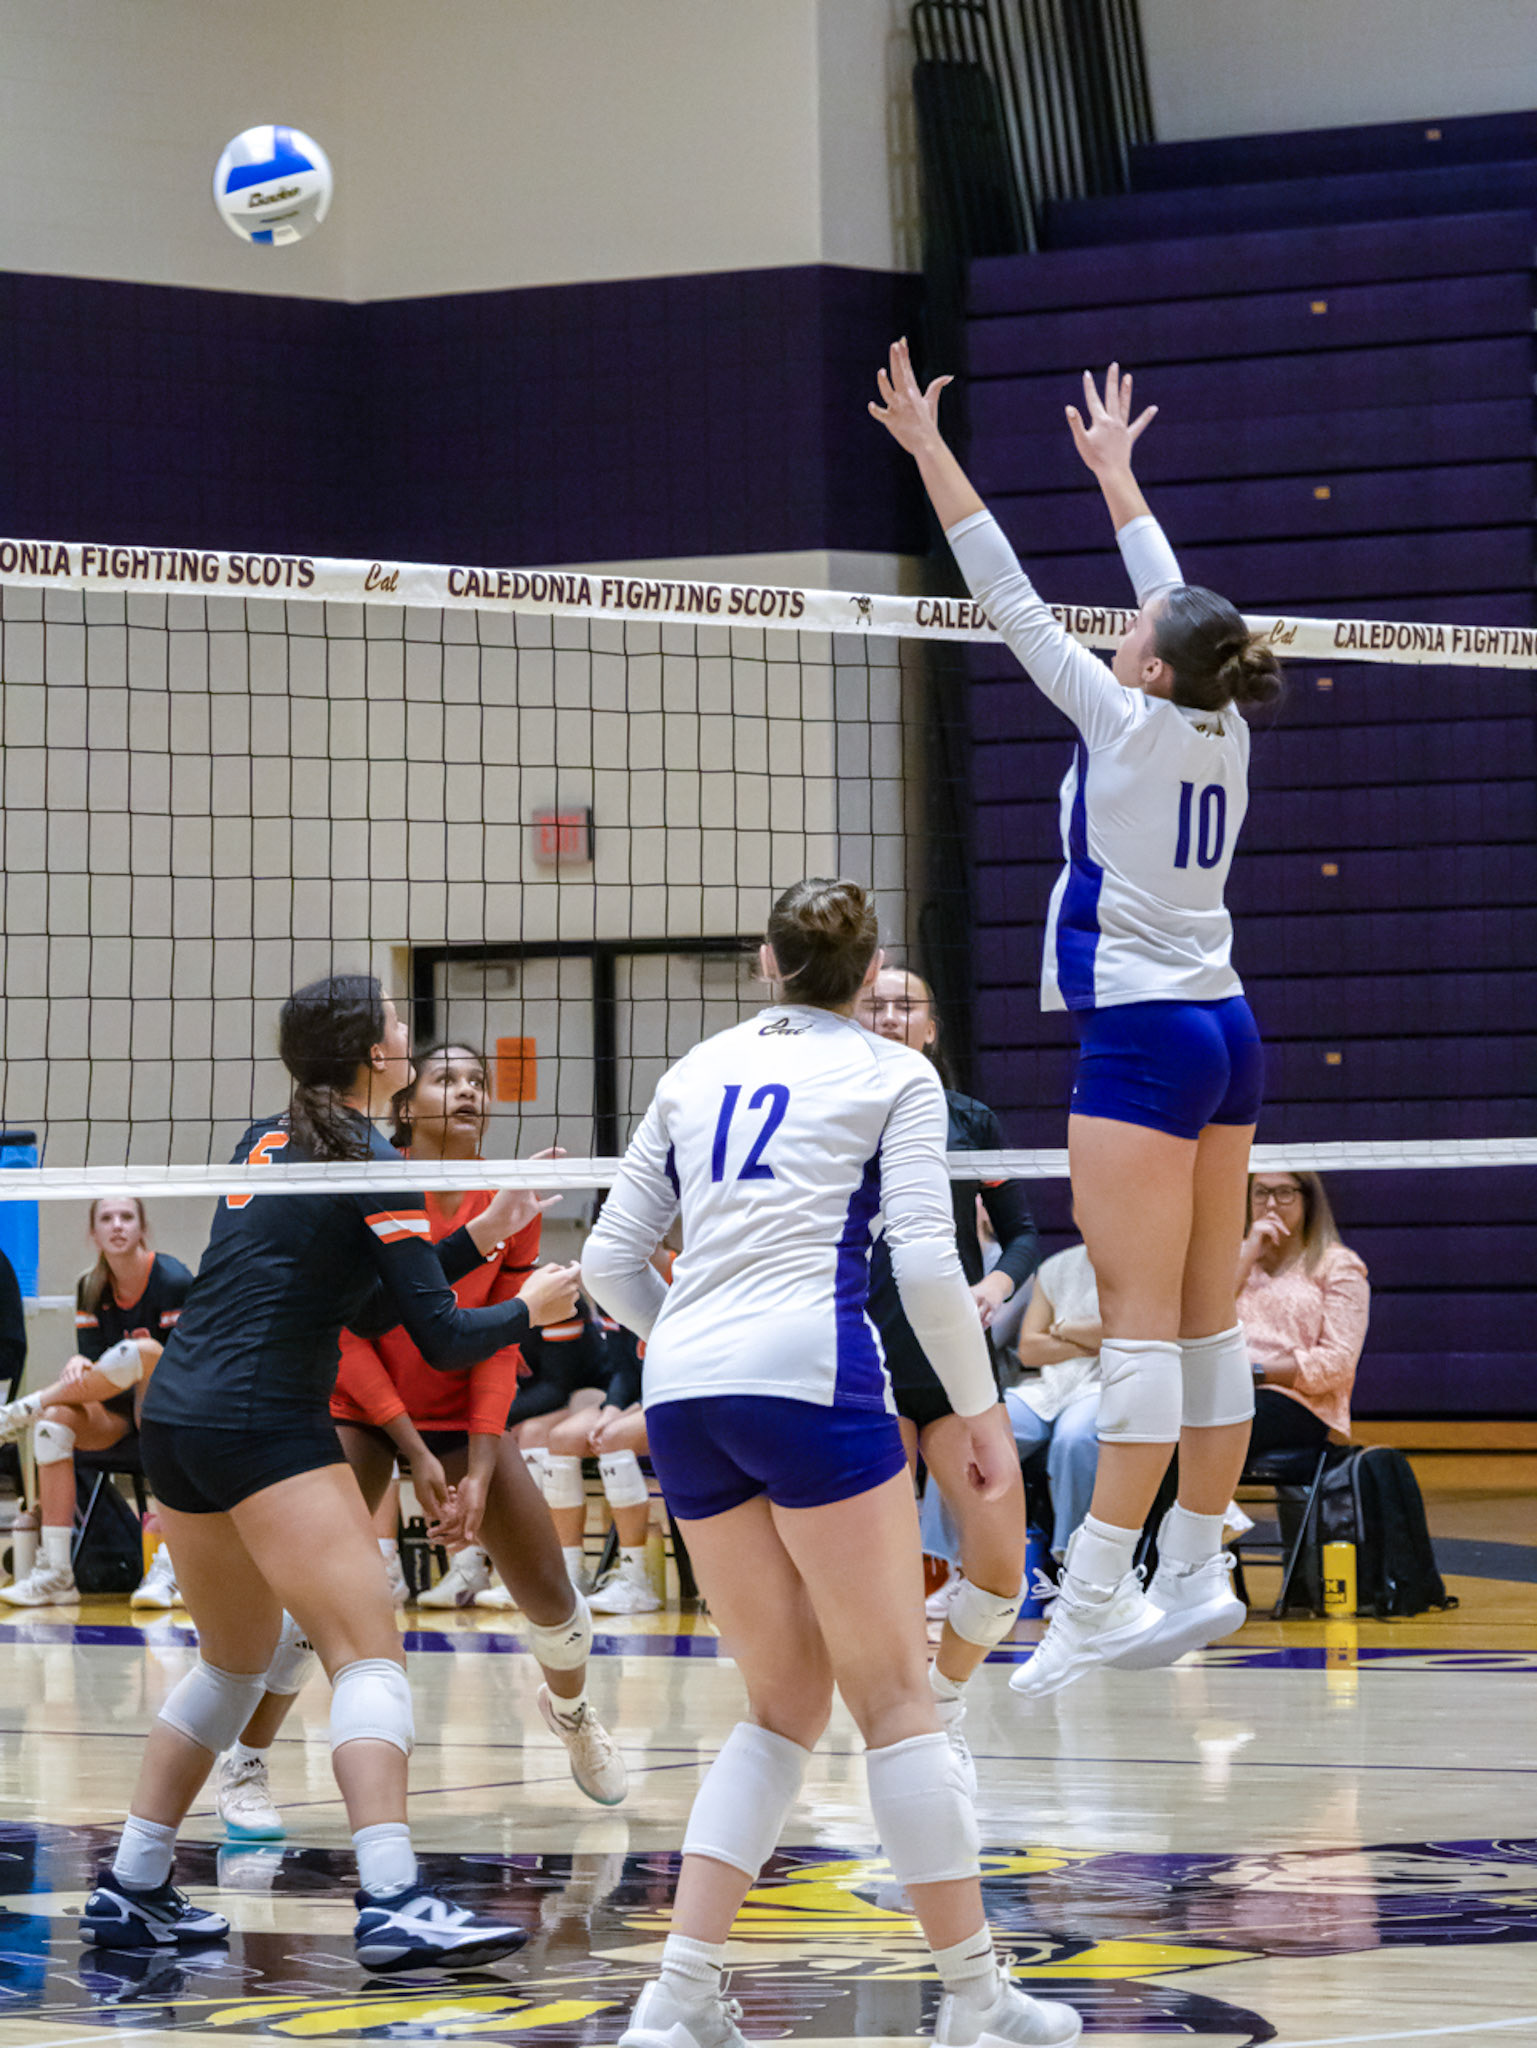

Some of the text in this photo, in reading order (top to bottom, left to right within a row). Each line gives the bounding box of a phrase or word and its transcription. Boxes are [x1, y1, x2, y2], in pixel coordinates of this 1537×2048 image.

[0, 541, 315, 588] ONIA FIGHTING SCOTS
[364, 563, 399, 592] Cal
[447, 568, 805, 618] CALEDONIA FIGHTING SCOTS
[1269, 619, 1297, 646] Cal
[1334, 623, 1537, 656] CALEDONIA FIGHTIN
[1174, 780, 1226, 869] 10
[711, 1083, 790, 1182] 12
